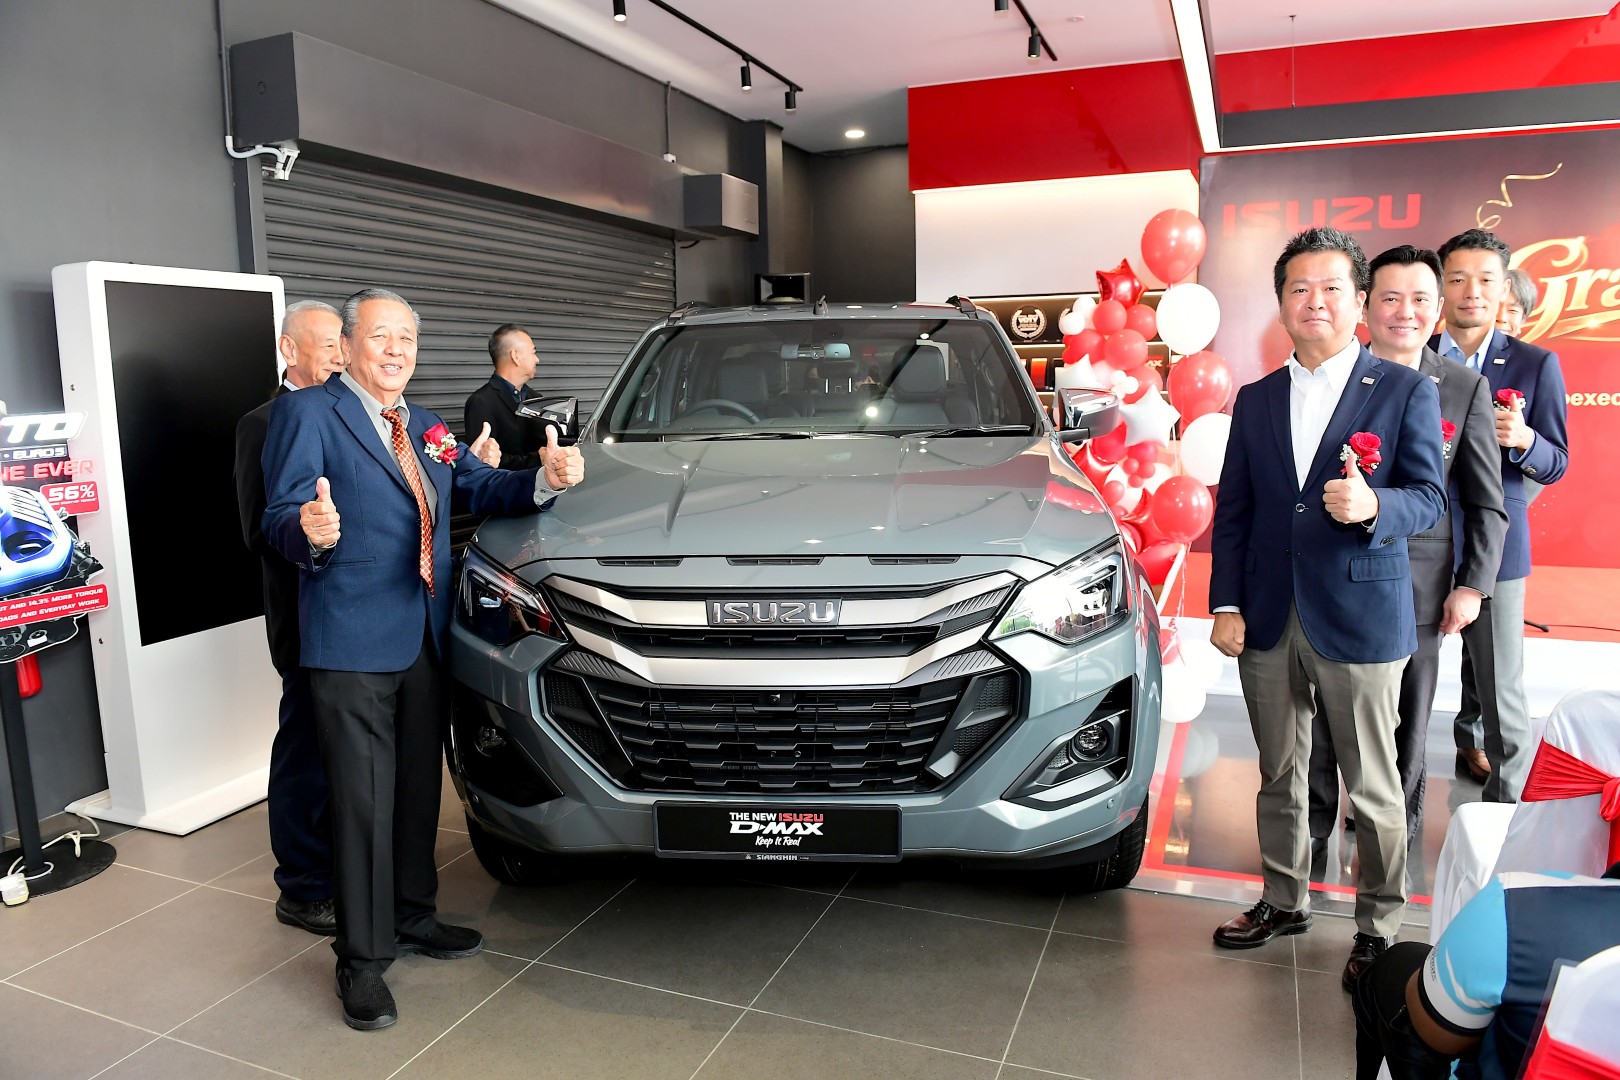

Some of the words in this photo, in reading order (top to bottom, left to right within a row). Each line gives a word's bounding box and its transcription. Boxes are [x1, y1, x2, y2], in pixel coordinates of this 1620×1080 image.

[1222, 193, 1422, 238] ISUZU
[33, 458, 93, 479] EVER
[48, 484, 95, 502] 56%
[10, 602, 27, 610] AND
[51, 594, 73, 602] MORE
[75, 588, 104, 598] TORQUE
[21, 610, 38, 618] AND
[39, 603, 76, 613] EVERYDAY
[78, 598, 100, 607] WORK
[713, 602, 834, 624] ISUZU
[729, 812, 750, 821] THE
[752, 812, 777, 821] NEW
[778, 813, 824, 822] ISUZU
[729, 821, 824, 836] D-MAX
[755, 835, 774, 848] Keep
[774, 836, 783, 846] It
[783, 836, 802, 846] Real
